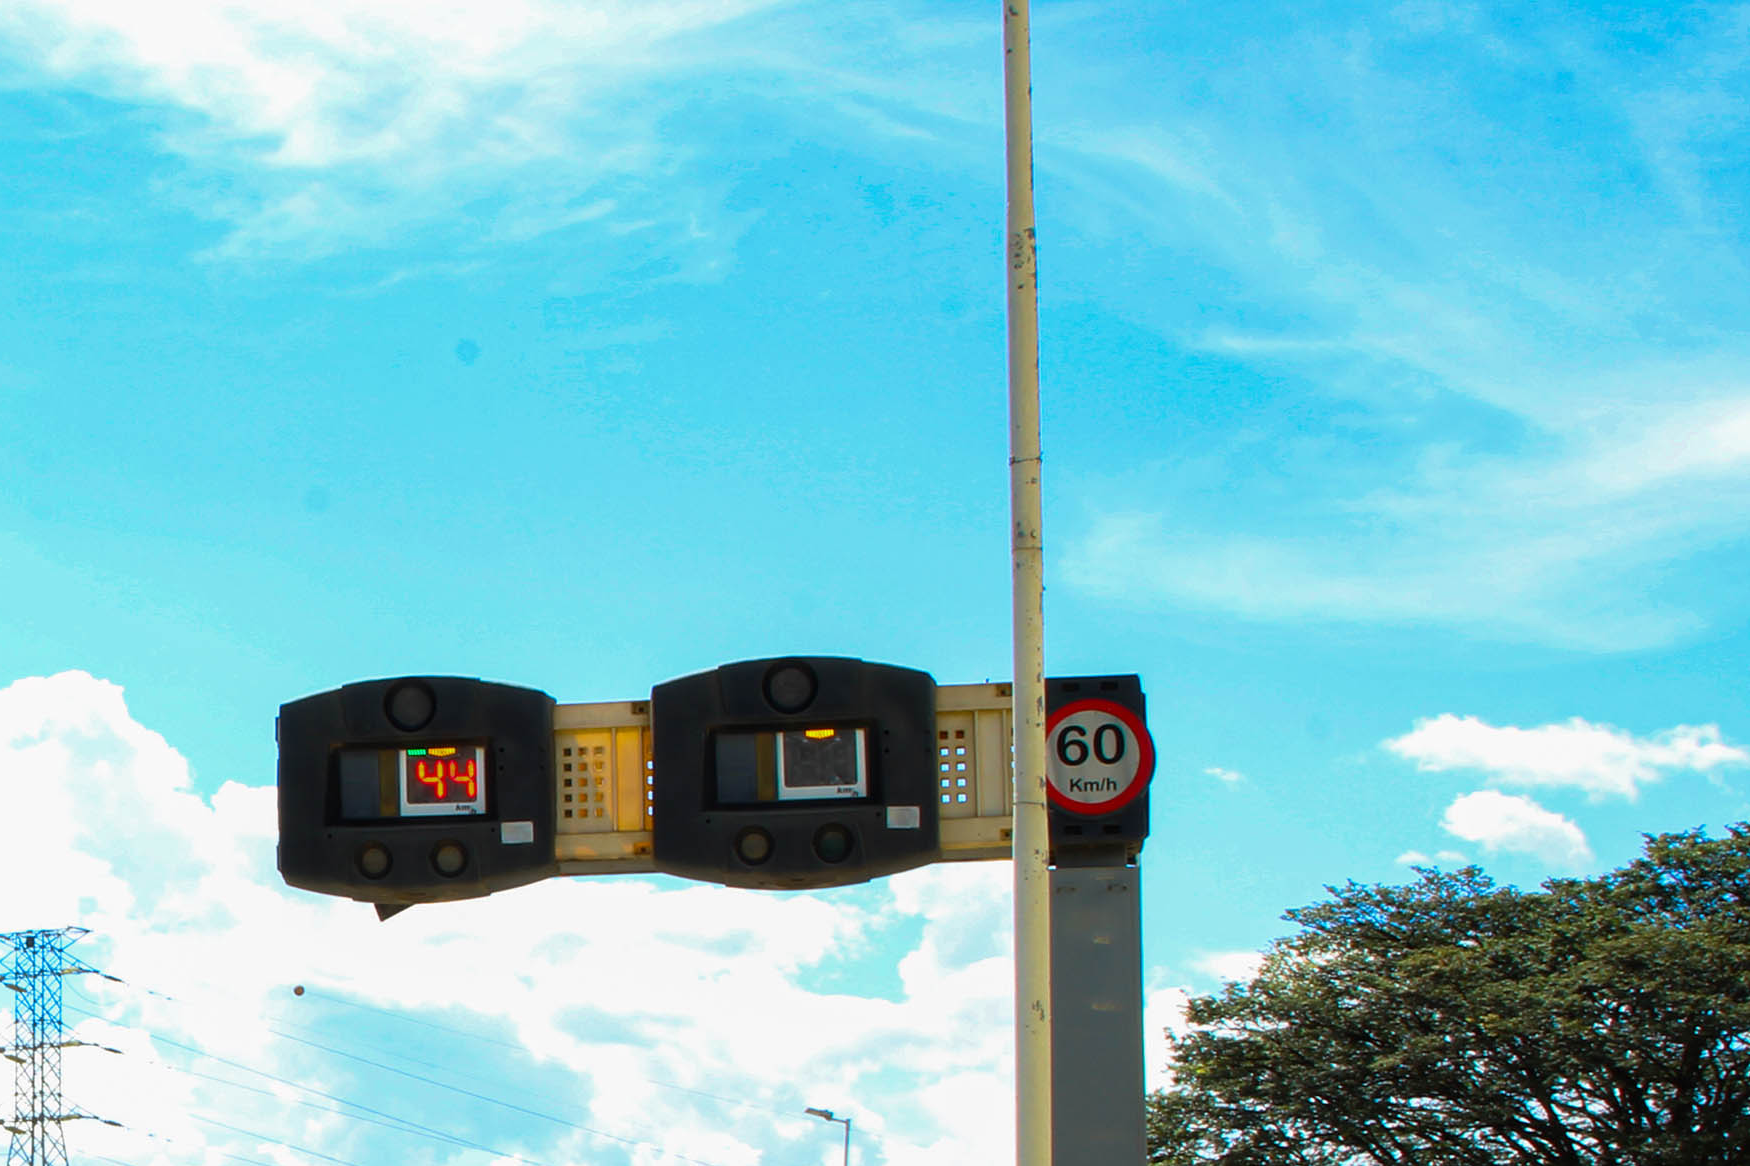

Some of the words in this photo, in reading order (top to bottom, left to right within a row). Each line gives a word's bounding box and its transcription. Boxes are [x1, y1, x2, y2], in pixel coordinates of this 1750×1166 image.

[1056, 724, 1126, 766] 60
[416, 760, 477, 799] 44
[1069, 778, 1118, 793] Km/h
